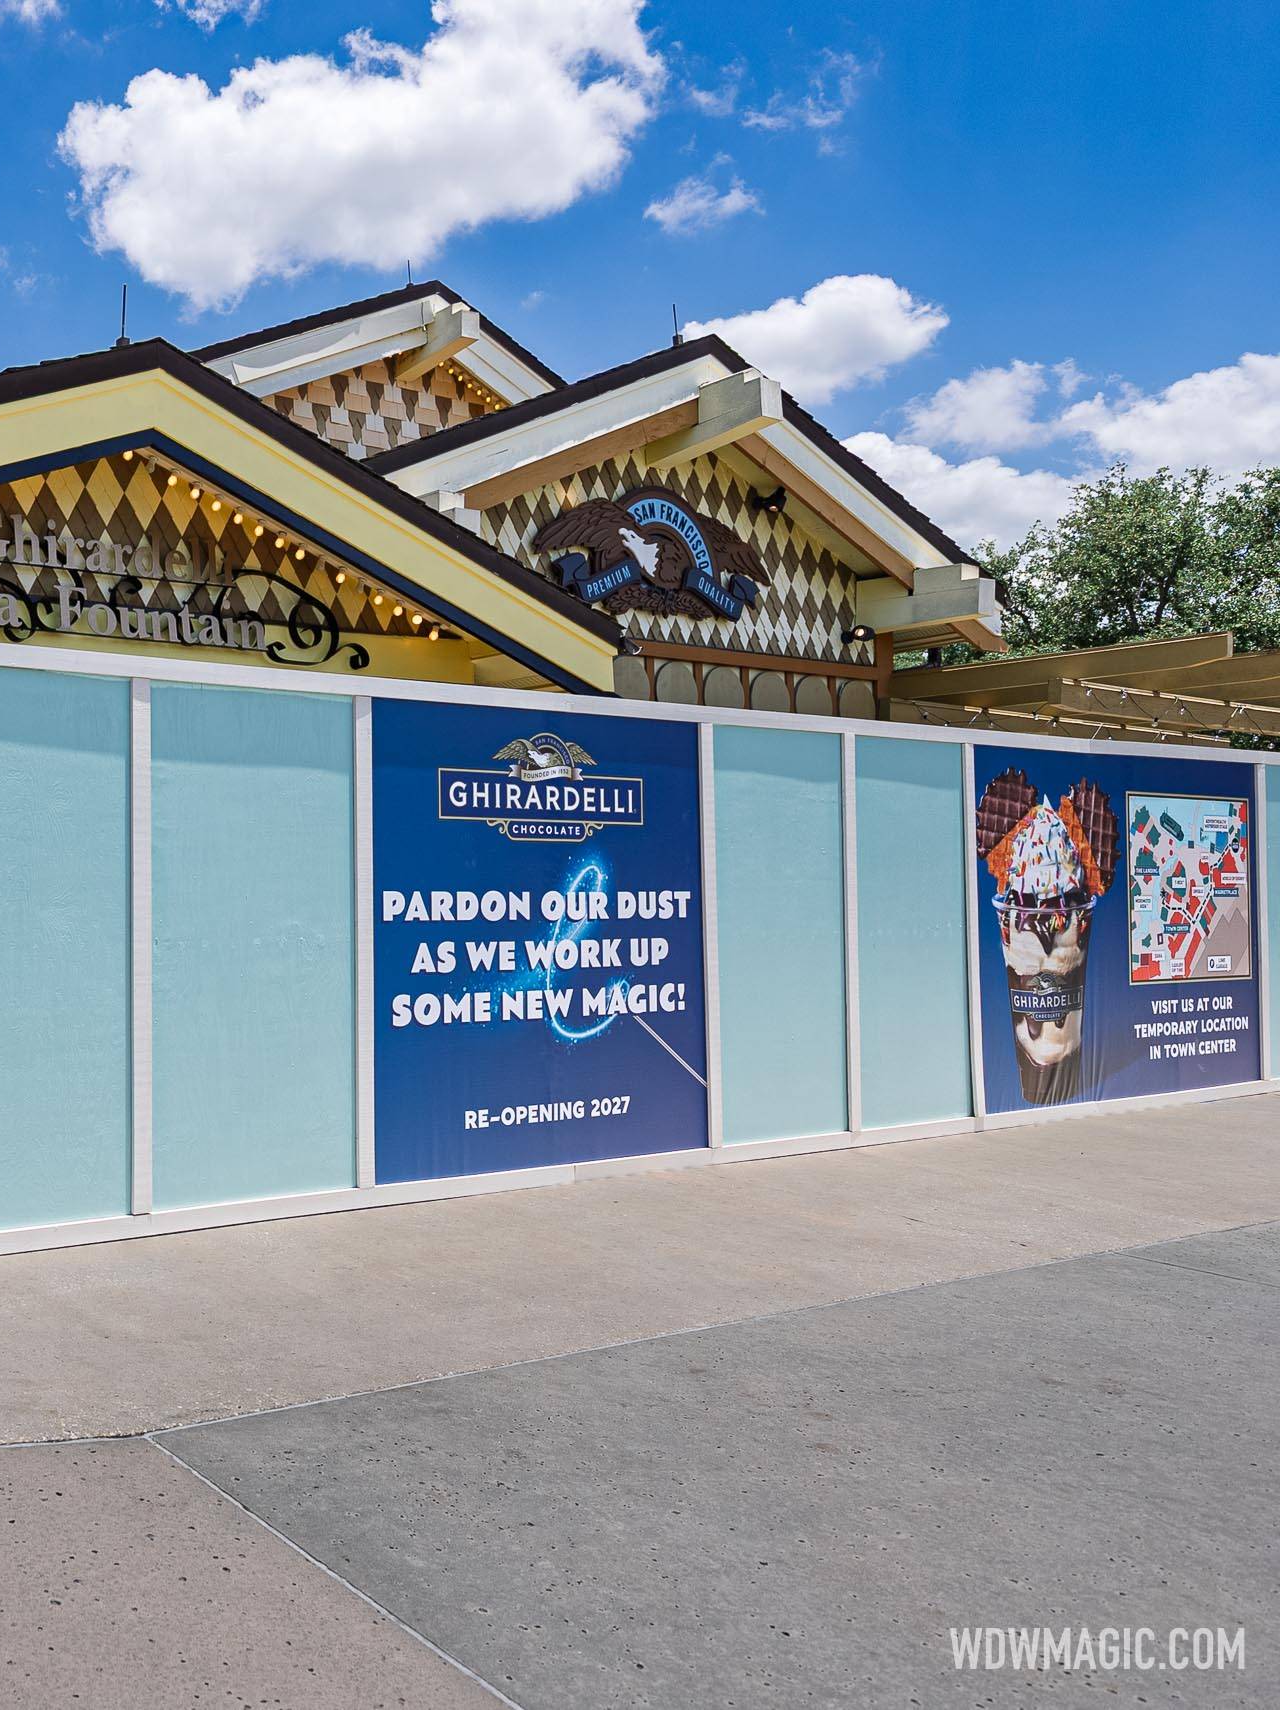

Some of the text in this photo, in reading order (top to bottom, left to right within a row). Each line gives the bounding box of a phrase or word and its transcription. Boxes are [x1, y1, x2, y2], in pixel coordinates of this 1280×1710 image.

[634, 503, 709, 570] SAN FRANCISCO
[586, 565, 631, 598] PREMIUM
[698, 577, 735, 613] QUALITY
[55, 584, 268, 651] Fountain
[523, 771, 550, 779] FOUNDED
[449, 781, 634, 813] GHIRARDELLI
[512, 824, 581, 836] CHOCOLATE
[382, 890, 691, 921] PARDON OUR DUST
[411, 937, 669, 973] AS WE WORK UP
[392, 983, 686, 1027] SOME NEW MAGIC!
[1014, 992, 1080, 1008] GHIRARDELLI
[1151, 996, 1233, 1014] VISIT US AT OUR
[1134, 1016, 1249, 1038] TEMPORARY LOCATION
[1150, 1039, 1236, 1059] IN TOWN CENTER
[464, 1096, 631, 1130] RE-OPENING 2027
